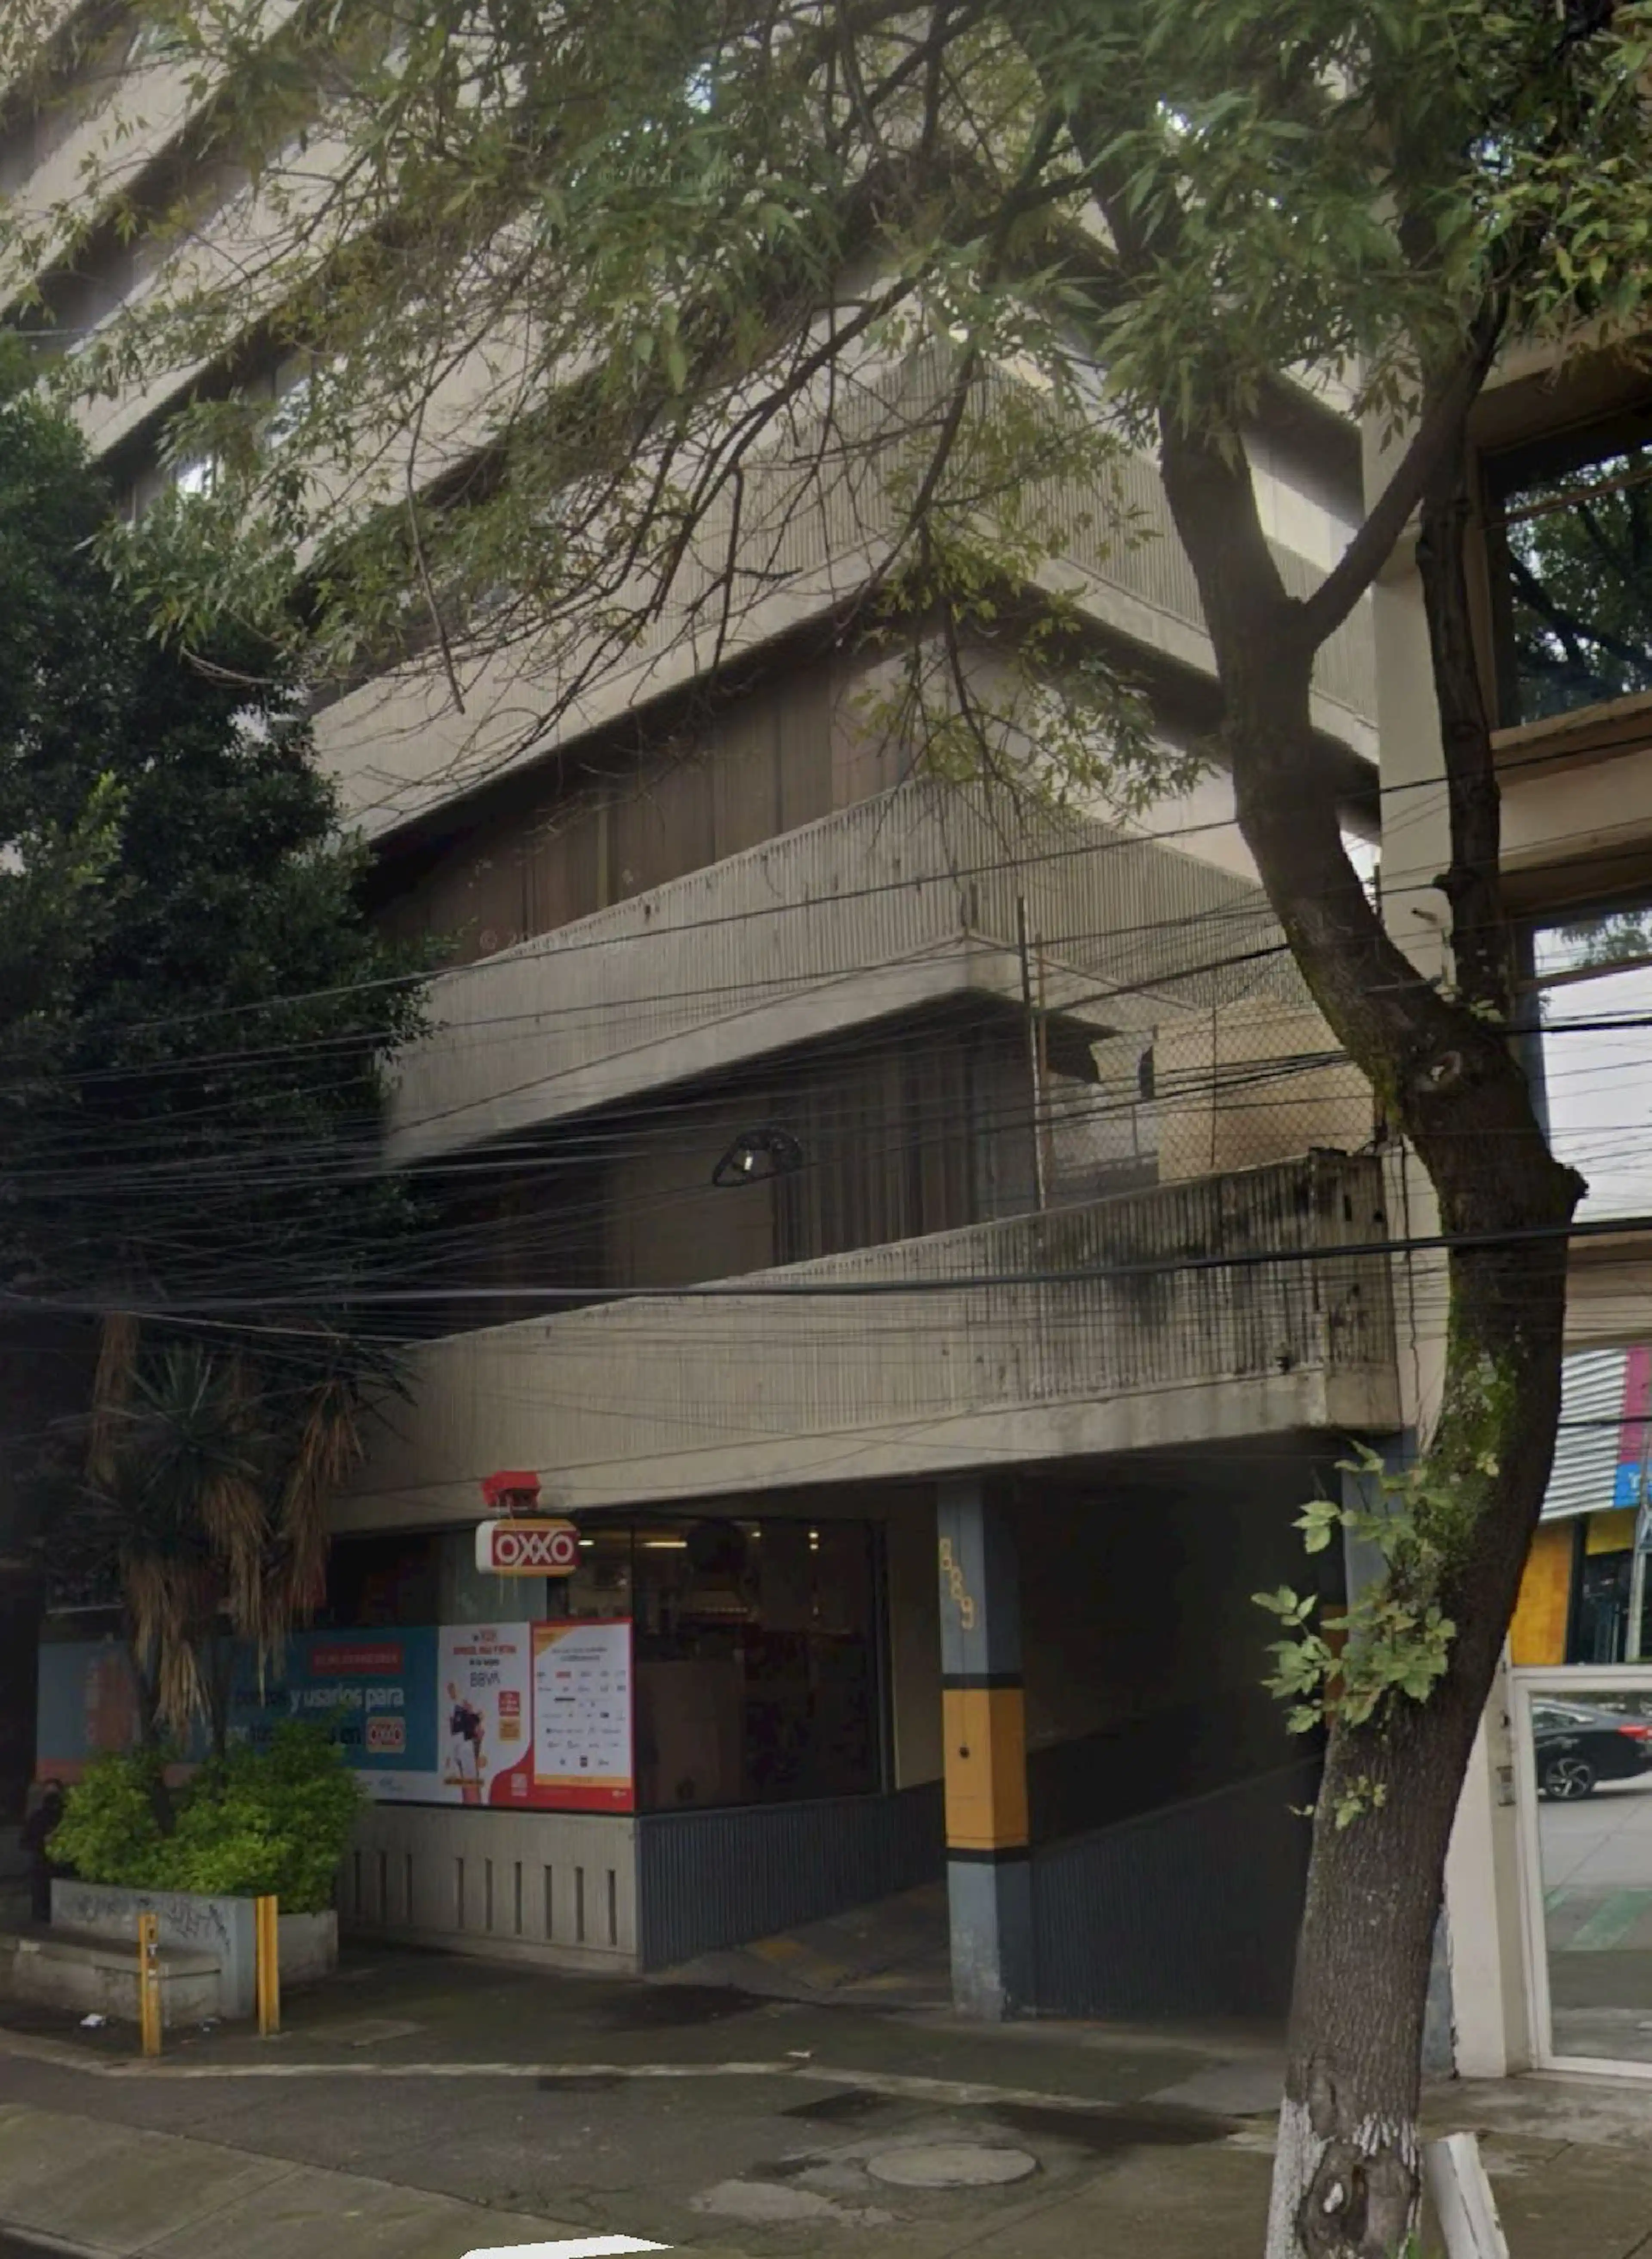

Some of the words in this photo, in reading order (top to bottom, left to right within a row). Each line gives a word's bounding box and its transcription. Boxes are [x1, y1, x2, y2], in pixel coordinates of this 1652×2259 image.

[496, 1531, 574, 1566] OXXO
[470, 1671, 501, 1688] BBVA
[365, 1687, 405, 1713] para
